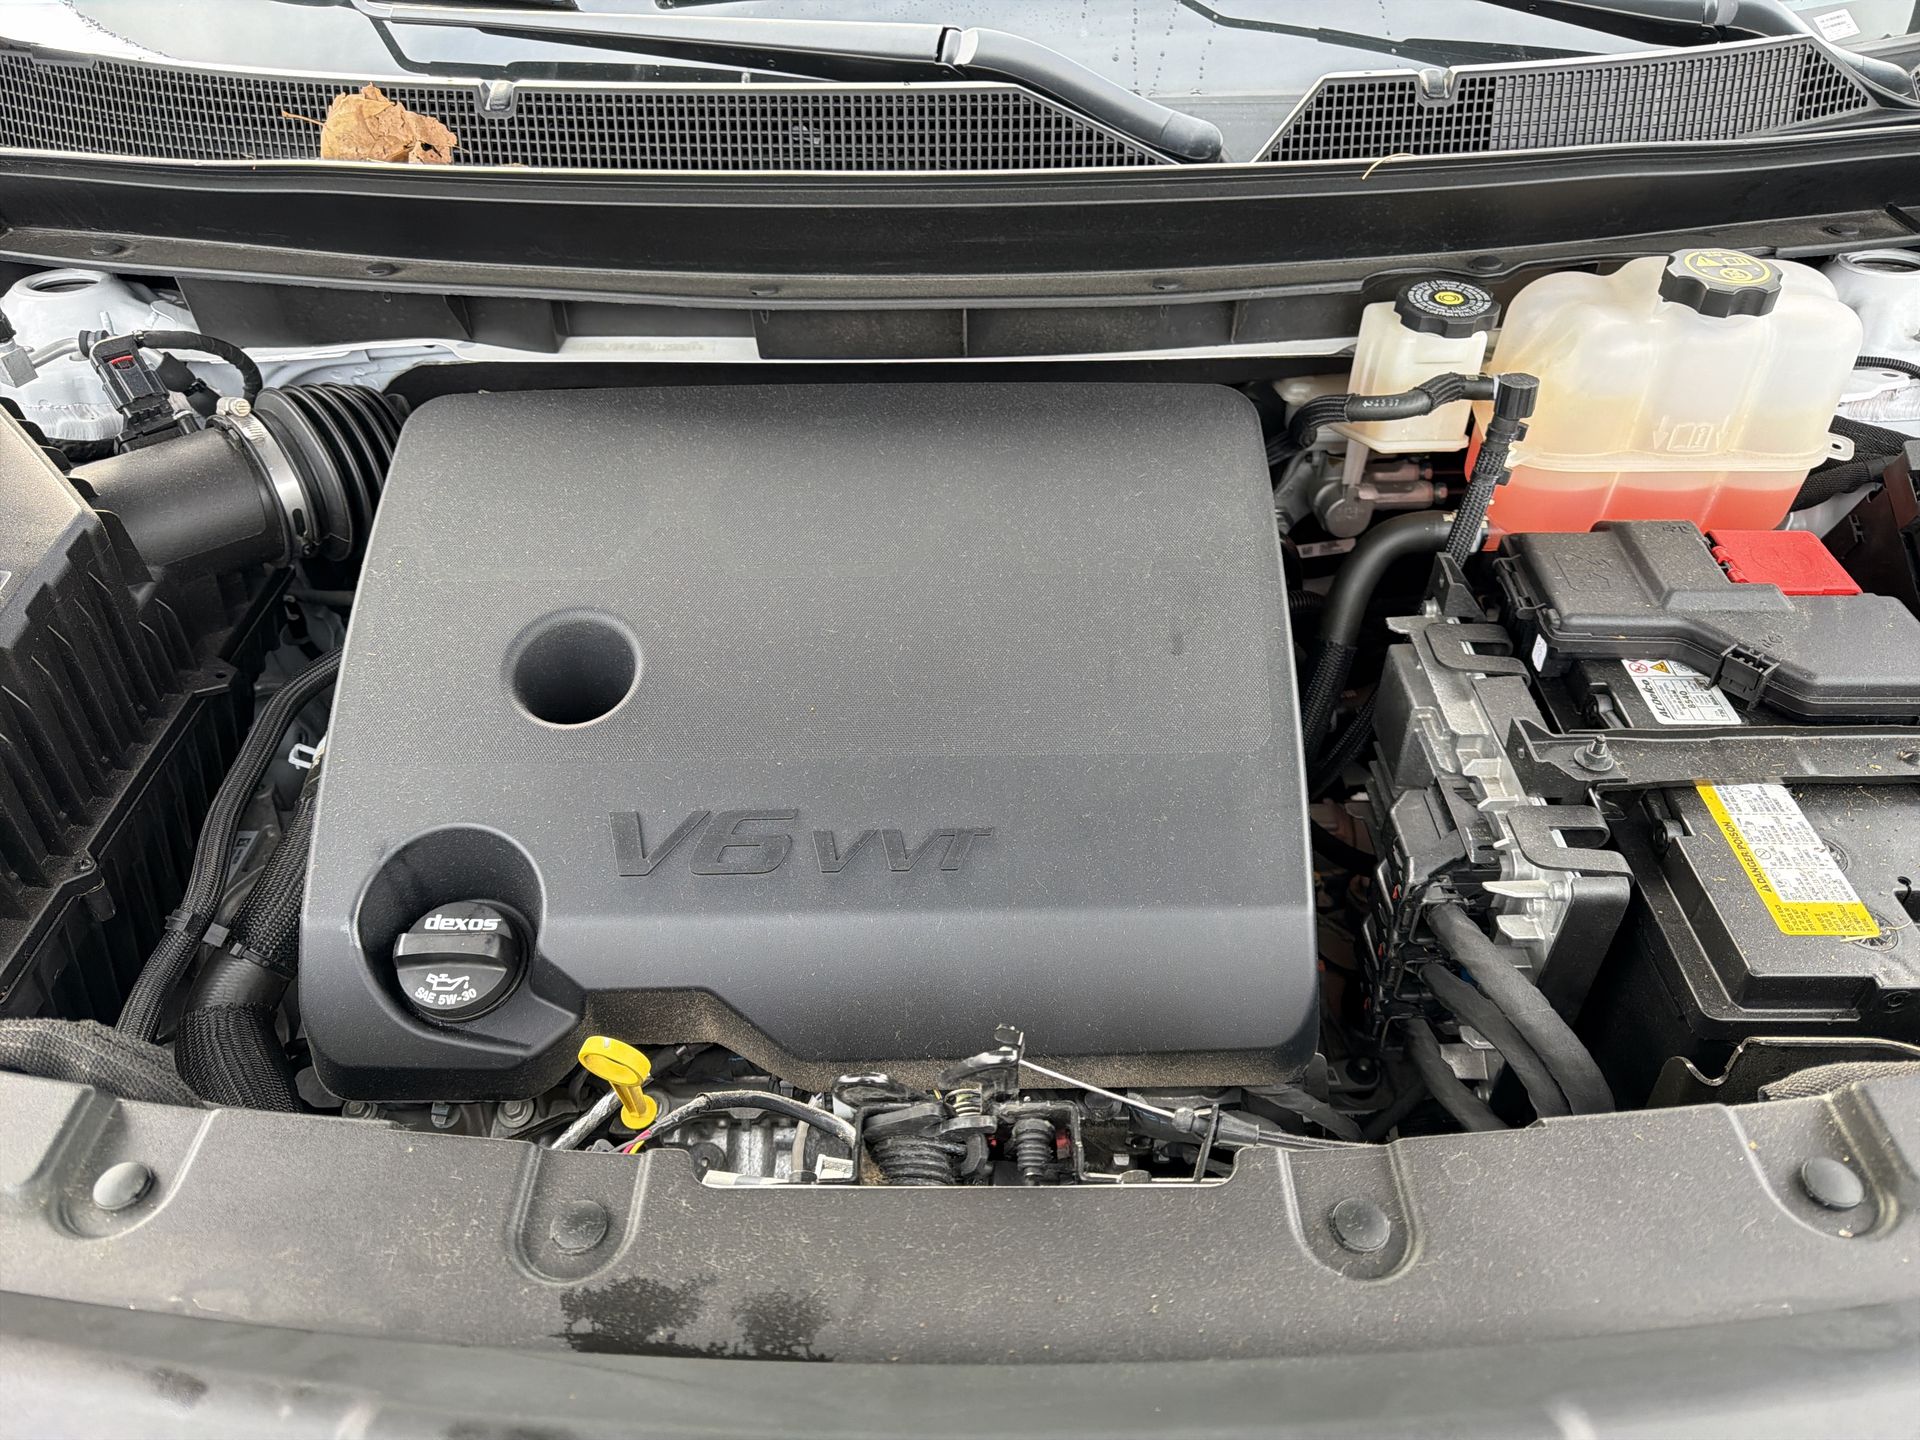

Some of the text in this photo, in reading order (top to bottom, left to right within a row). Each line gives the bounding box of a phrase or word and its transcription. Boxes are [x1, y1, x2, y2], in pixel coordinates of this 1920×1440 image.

[1641, 679, 1669, 718] ACDelco
[609, 809, 993, 877] V6 VVT
[424, 914, 502, 931] dexos
[415, 986, 477, 1005] SAE 5W-30
